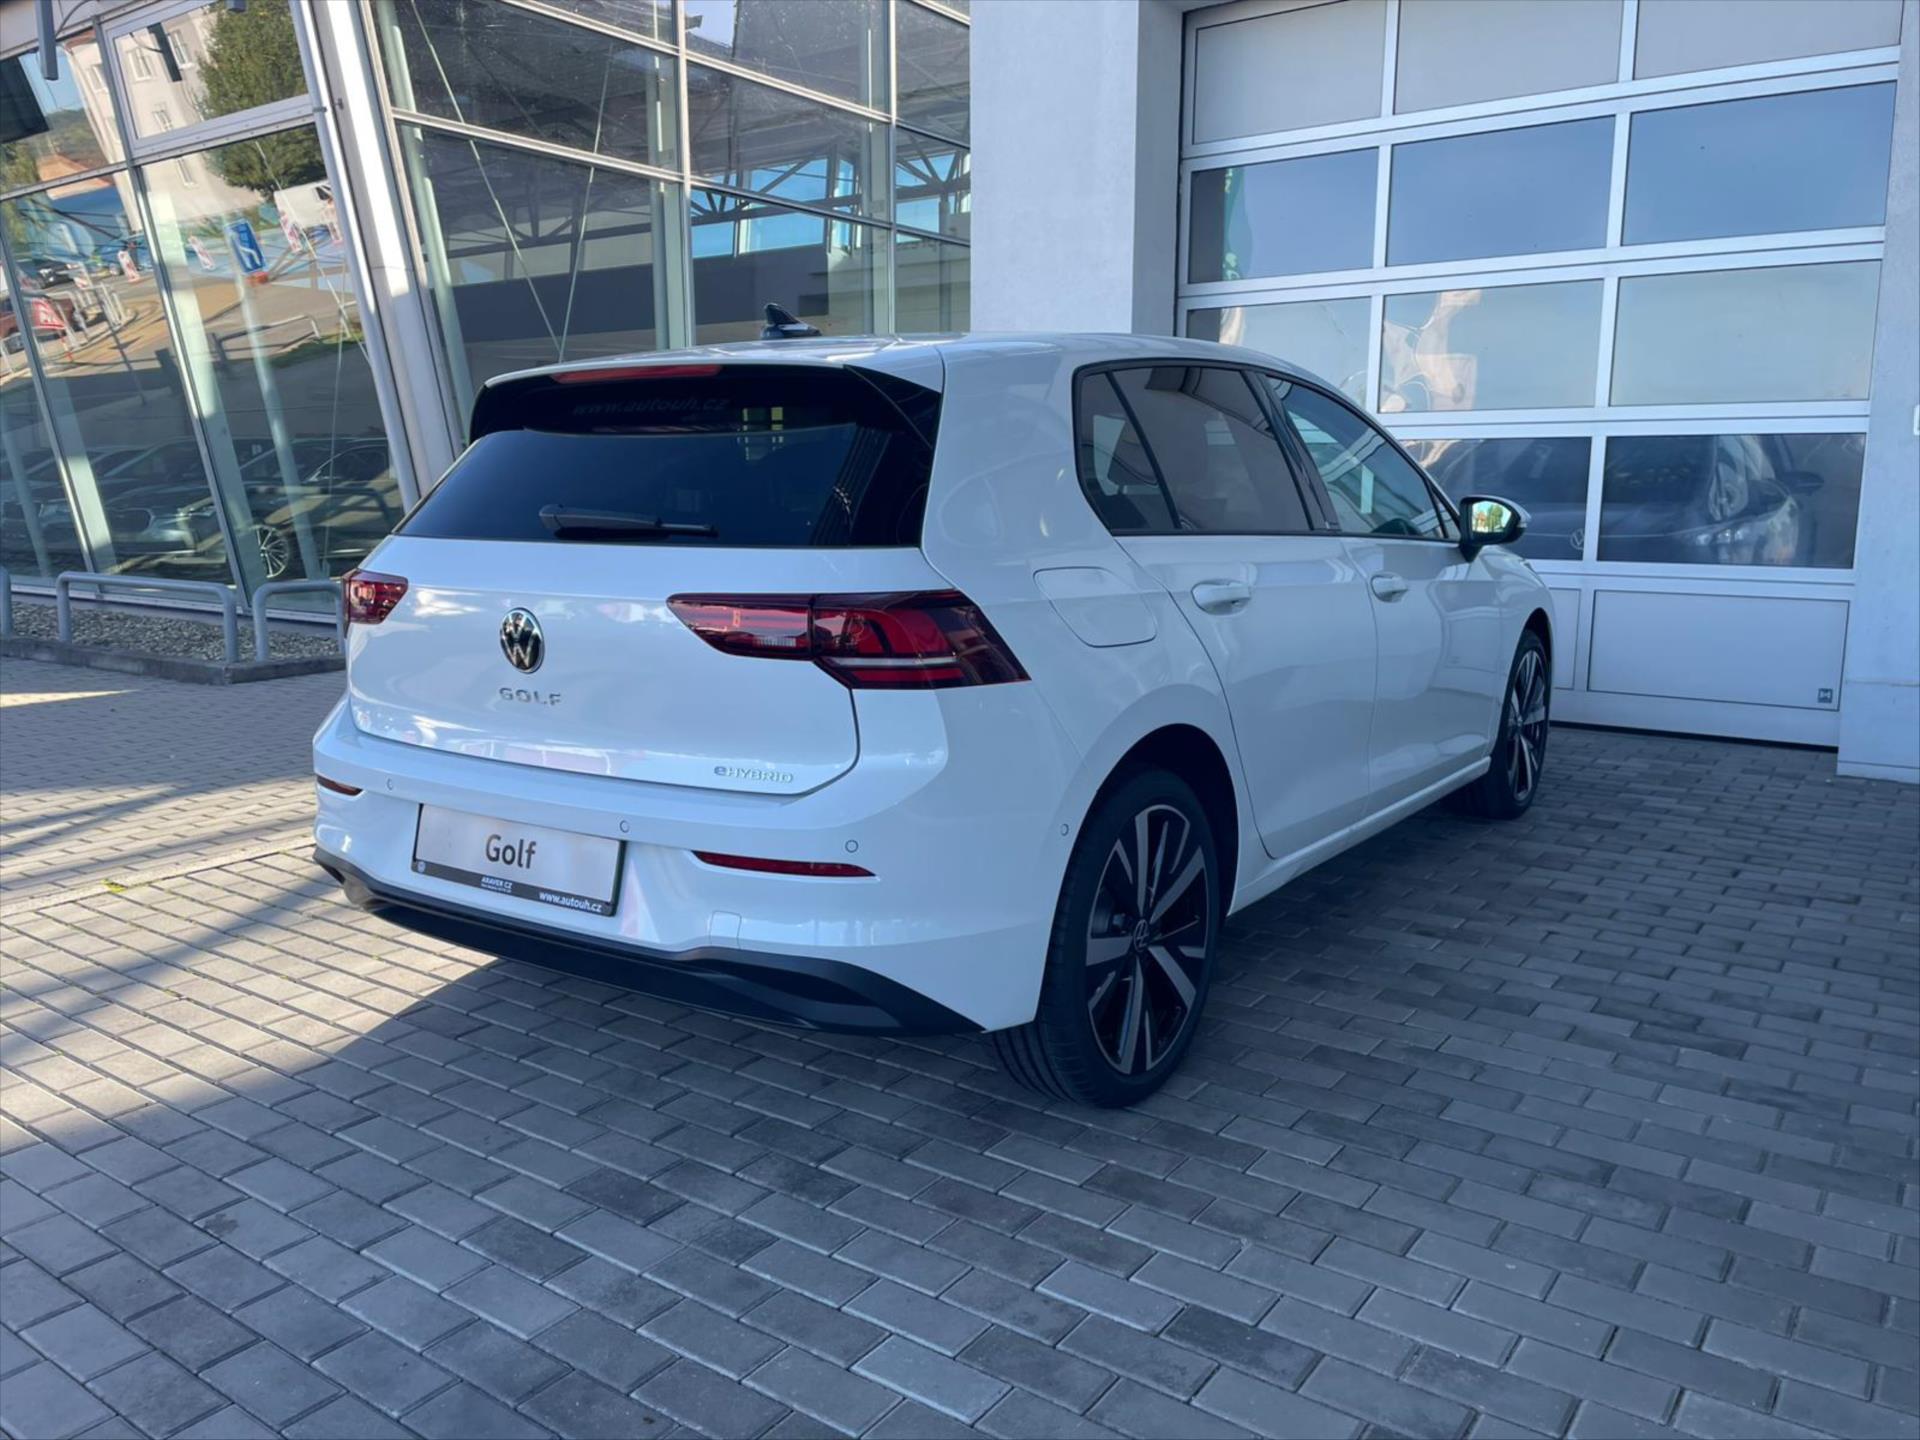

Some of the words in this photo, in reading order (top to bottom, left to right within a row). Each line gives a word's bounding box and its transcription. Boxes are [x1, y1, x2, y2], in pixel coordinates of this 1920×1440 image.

[573, 396, 730, 415] www.autouh.cz
[499, 687, 561, 705] GOLF
[713, 766, 794, 783] eHYBRID
[486, 834, 537, 869] Golf
[539, 891, 602, 912] www.autouh.cz
